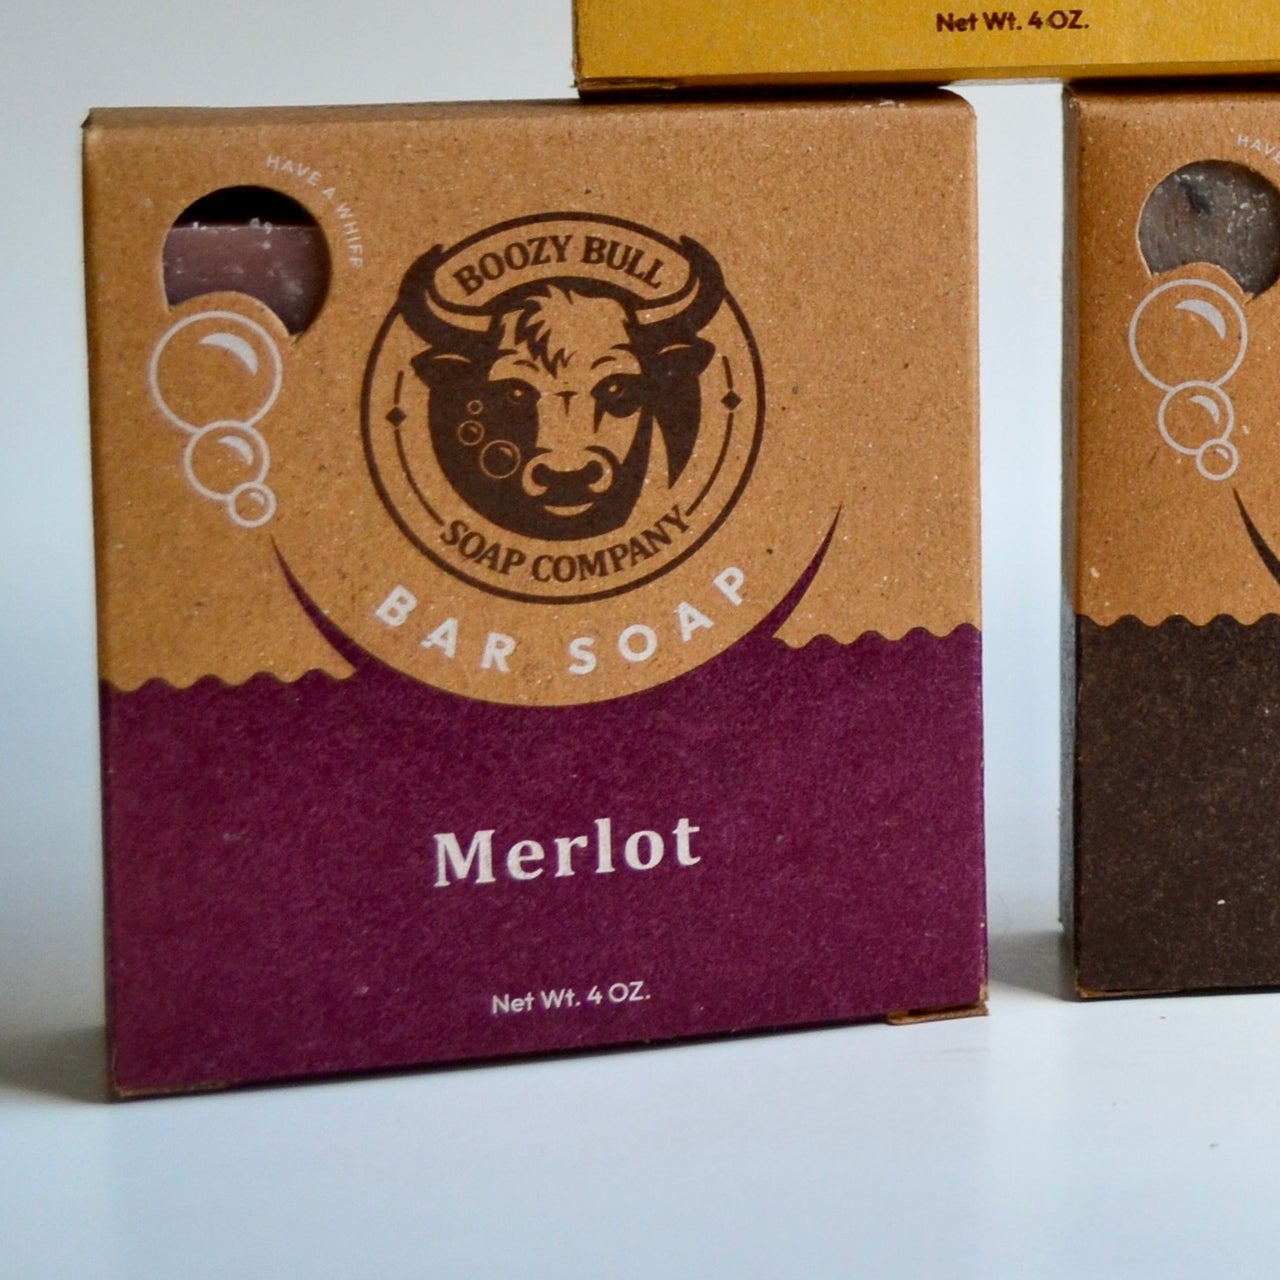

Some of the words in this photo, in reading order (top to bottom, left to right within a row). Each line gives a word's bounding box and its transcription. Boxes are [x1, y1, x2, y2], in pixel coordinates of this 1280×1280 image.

[936, 12, 978, 32] Net
[982, 12, 1022, 31] Wt.
[1028, 11, 1043, 29] 4
[1047, 10, 1089, 29] OZ.
[265, 153, 322, 187] HAVE
[321, 187, 337, 199] A
[334, 203, 364, 268] WHIFF
[451, 233, 573, 297] BOOZY
[579, 235, 664, 289] BULL
[439, 519, 526, 576] SOAP
[531, 506, 690, 583] COMPANY
[374, 584, 517, 673] BAR
[568, 566, 745, 676] SOAP
[433, 817, 701, 887] Merlot
[492, 992, 535, 1014] Net
[541, 988, 581, 1009] Wt.
[587, 985, 603, 1004] 4
[608, 980, 651, 1002] OZ.
